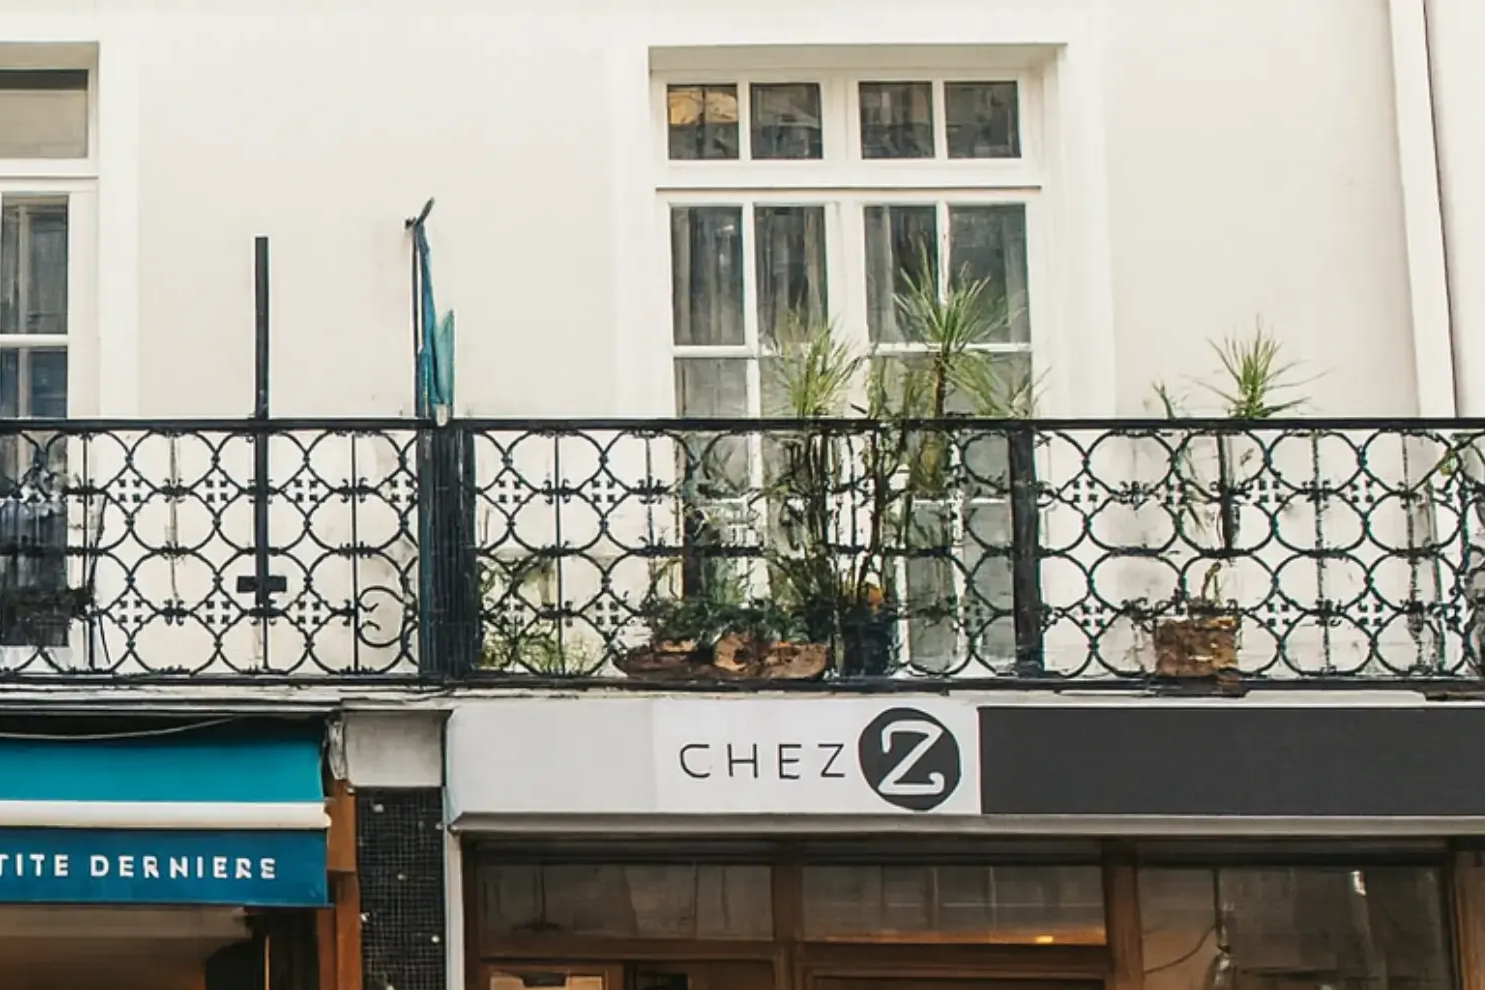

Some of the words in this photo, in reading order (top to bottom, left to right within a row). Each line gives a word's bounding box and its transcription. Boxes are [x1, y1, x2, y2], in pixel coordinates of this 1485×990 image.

[680, 743, 846, 779] CHEZ
[879, 719, 946, 795] Z
[90, 855, 276, 879] DERNIERE
